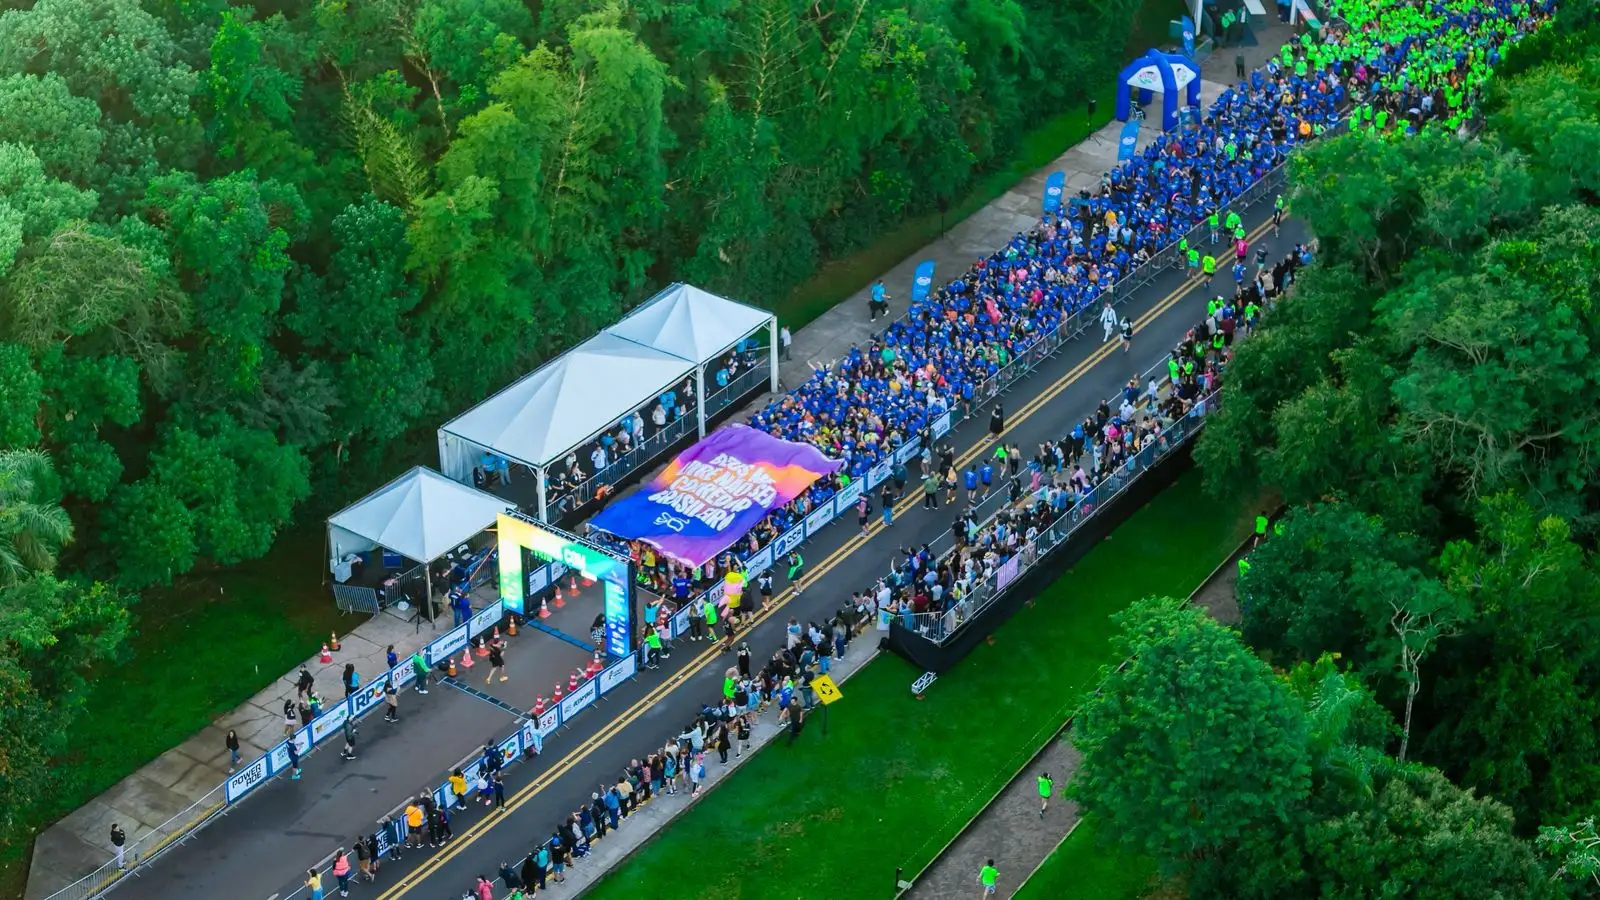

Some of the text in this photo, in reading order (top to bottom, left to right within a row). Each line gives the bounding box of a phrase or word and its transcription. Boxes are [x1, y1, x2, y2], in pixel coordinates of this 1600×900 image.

[355, 679, 385, 712] RPC
[232, 763, 261, 788] POWER
[246, 772, 262, 788] ADE
